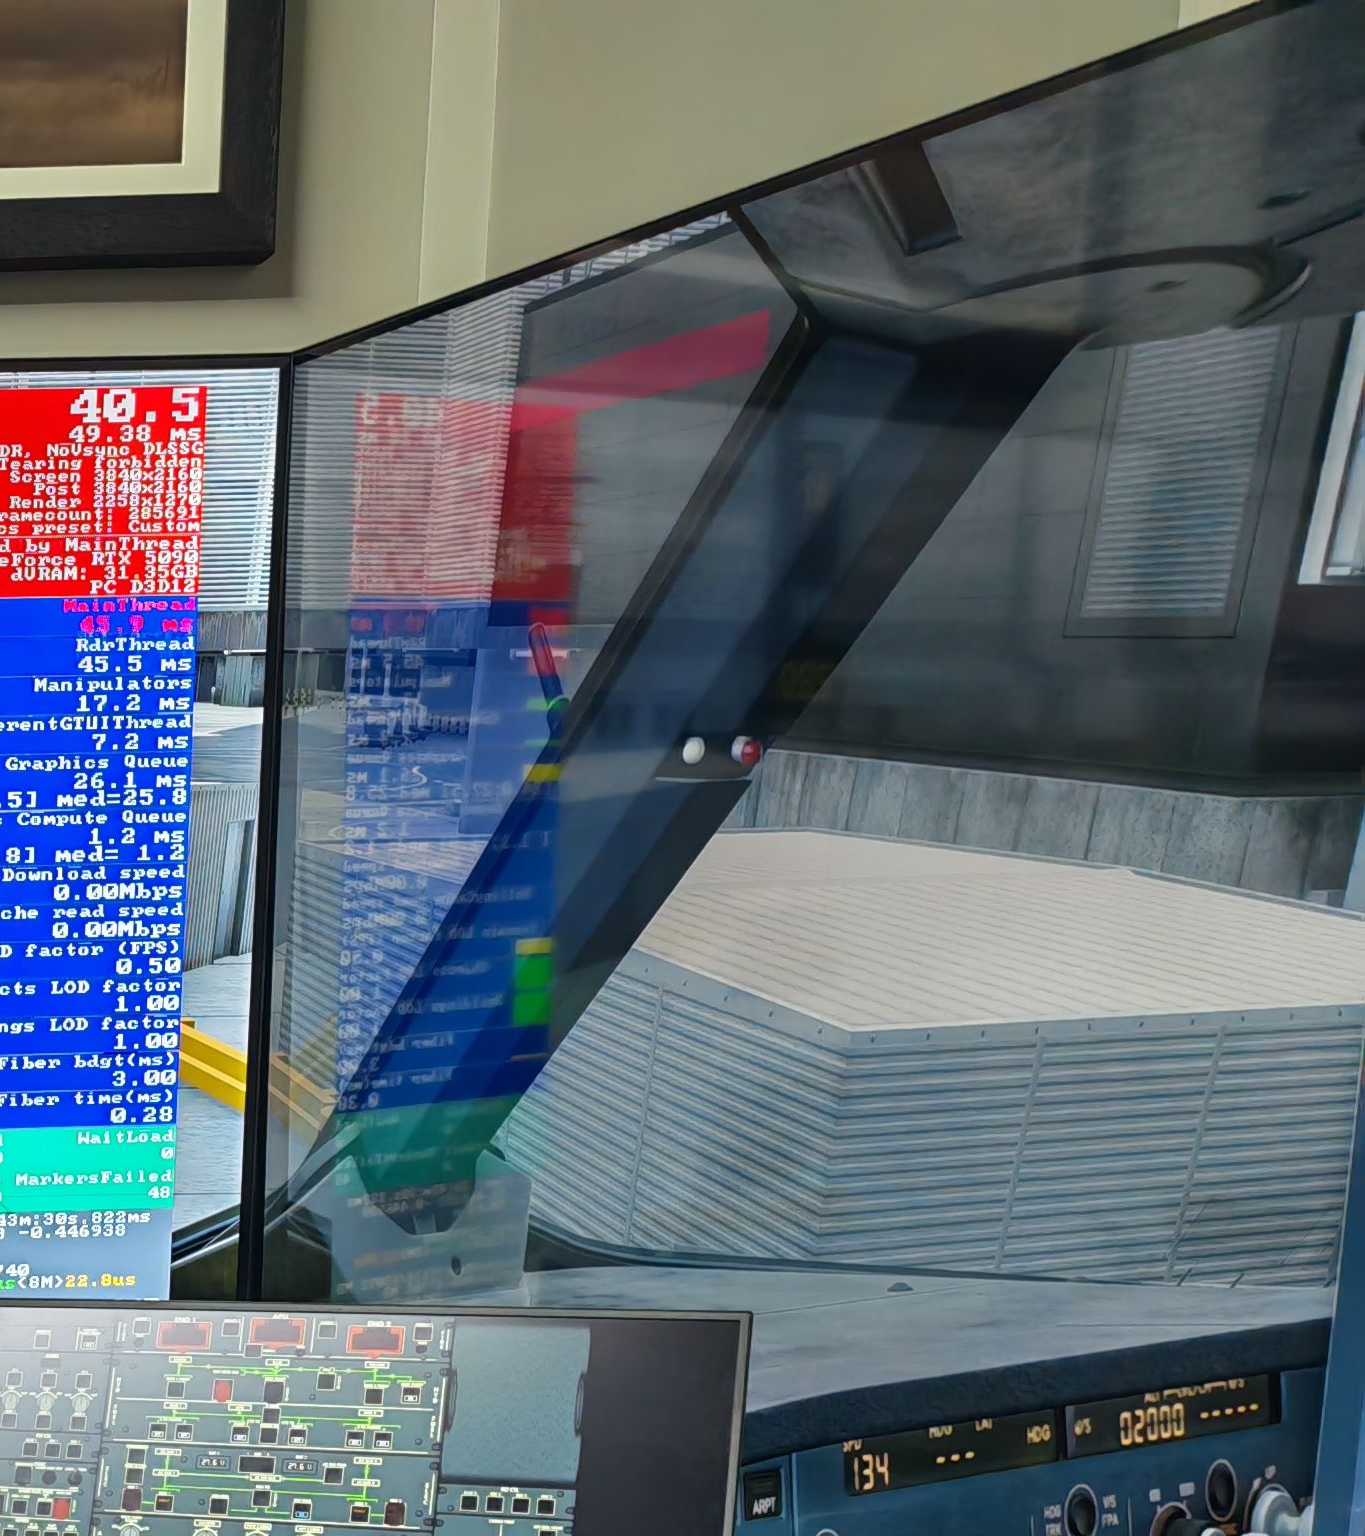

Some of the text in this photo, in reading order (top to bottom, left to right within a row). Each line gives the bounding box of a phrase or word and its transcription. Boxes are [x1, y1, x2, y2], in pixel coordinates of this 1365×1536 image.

[69, 388, 199, 423] 40.5
[69, 425, 201, 442] 49.38 ms
[47, 443, 130, 458] NoVsync
[143, 441, 204, 455] DLSSG
[94, 456, 202, 469] forbidden
[9, 468, 202, 483] Screen 3840x2160
[33, 481, 202, 496] Post 3840x2160
[9, 494, 201, 509] Render 2258x1270
[128, 507, 199, 520] 285691
[32, 522, 113, 535] preset:
[128, 520, 200, 532] Custom
[25, 539, 50, 555] by
[65, 536, 199, 551] MainThread
[91, 552, 131, 565] RTX
[145, 550, 199, 564] 5090
[11, 567, 88, 582] dVRAM:
[104, 565, 199, 581] 31.35GB
[90, 580, 195, 594] PC D3D12
[76, 637, 194, 652] RdrThread
[77, 656, 192, 673] 45.5 ms
[33, 676, 192, 693] Manipulators
[76, 694, 190, 712] 17.2 ms
[92, 733, 188, 750] 7.2 ms
[5, 754, 187, 772] Graphics Queue
[74, 772, 186, 789] 26.1 ms
[17, 812, 107, 826] Compute
[122, 809, 186, 824] Queue
[2, 865, 185, 882] Download speed
[54, 884, 182, 902] 0.00Mbps
[53, 904, 104, 919] read
[119, 903, 184, 919] speed
[52, 921, 181, 939] 0.00Mbps
[25, 943, 104, 957] factor
[119, 940, 179, 955] (FPS)
[116, 959, 181, 975] 0.50
[51, 981, 90, 995] LOD
[102, 980, 180, 992] factor
[114, 996, 179, 1013] 1.00
[50, 1018, 88, 1031] LOD
[101, 1016, 179, 1030] factor
[113, 1033, 178, 1050] 1.00
[74, 1054, 175, 1070] bdgt(ms)
[112, 1070, 177, 1087] 3.00
[75, 1090, 173, 1104] time(ms)
[110, 1107, 173, 1124] 0.28
